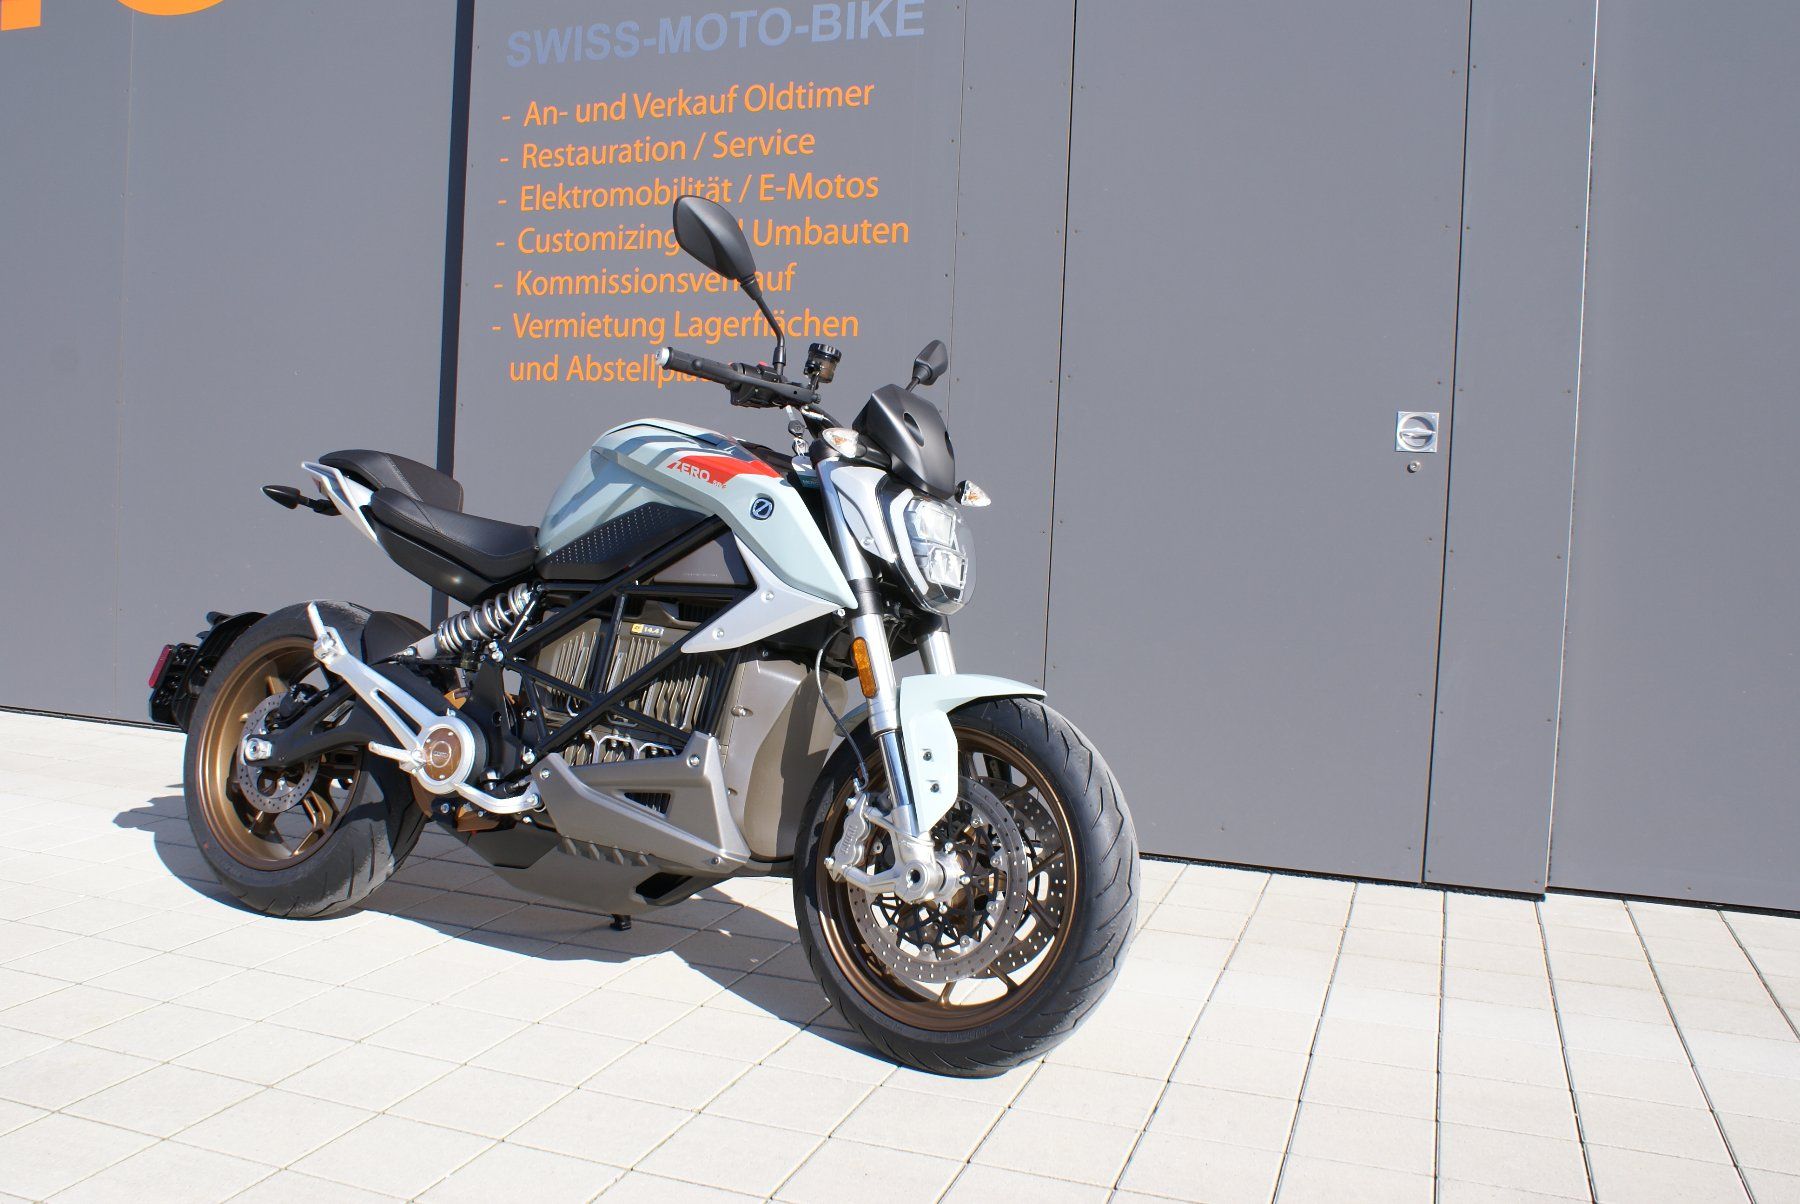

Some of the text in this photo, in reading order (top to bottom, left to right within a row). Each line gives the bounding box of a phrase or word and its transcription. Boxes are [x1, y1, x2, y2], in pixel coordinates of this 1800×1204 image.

[506, 0, 926, 68] SWISS-MOTO-BIKE
[523, 101, 569, 127] An-
[575, 93, 628, 124] und
[633, 84, 739, 119] Verkauf
[743, 81, 875, 112] Oldtimer
[522, 135, 687, 169] Restauration
[693, 132, 707, 161] /
[712, 128, 816, 160] Service
[520, 177, 734, 212] Elektromobilität
[738, 175, 753, 204] /
[758, 172, 880, 202] E-Motos
[517, 223, 682, 256] Customizing
[752, 215, 910, 248] Umbauten
[513, 311, 667, 346] Vermietung
[509, 354, 560, 382] und
[668, 461, 711, 482] ZERO
